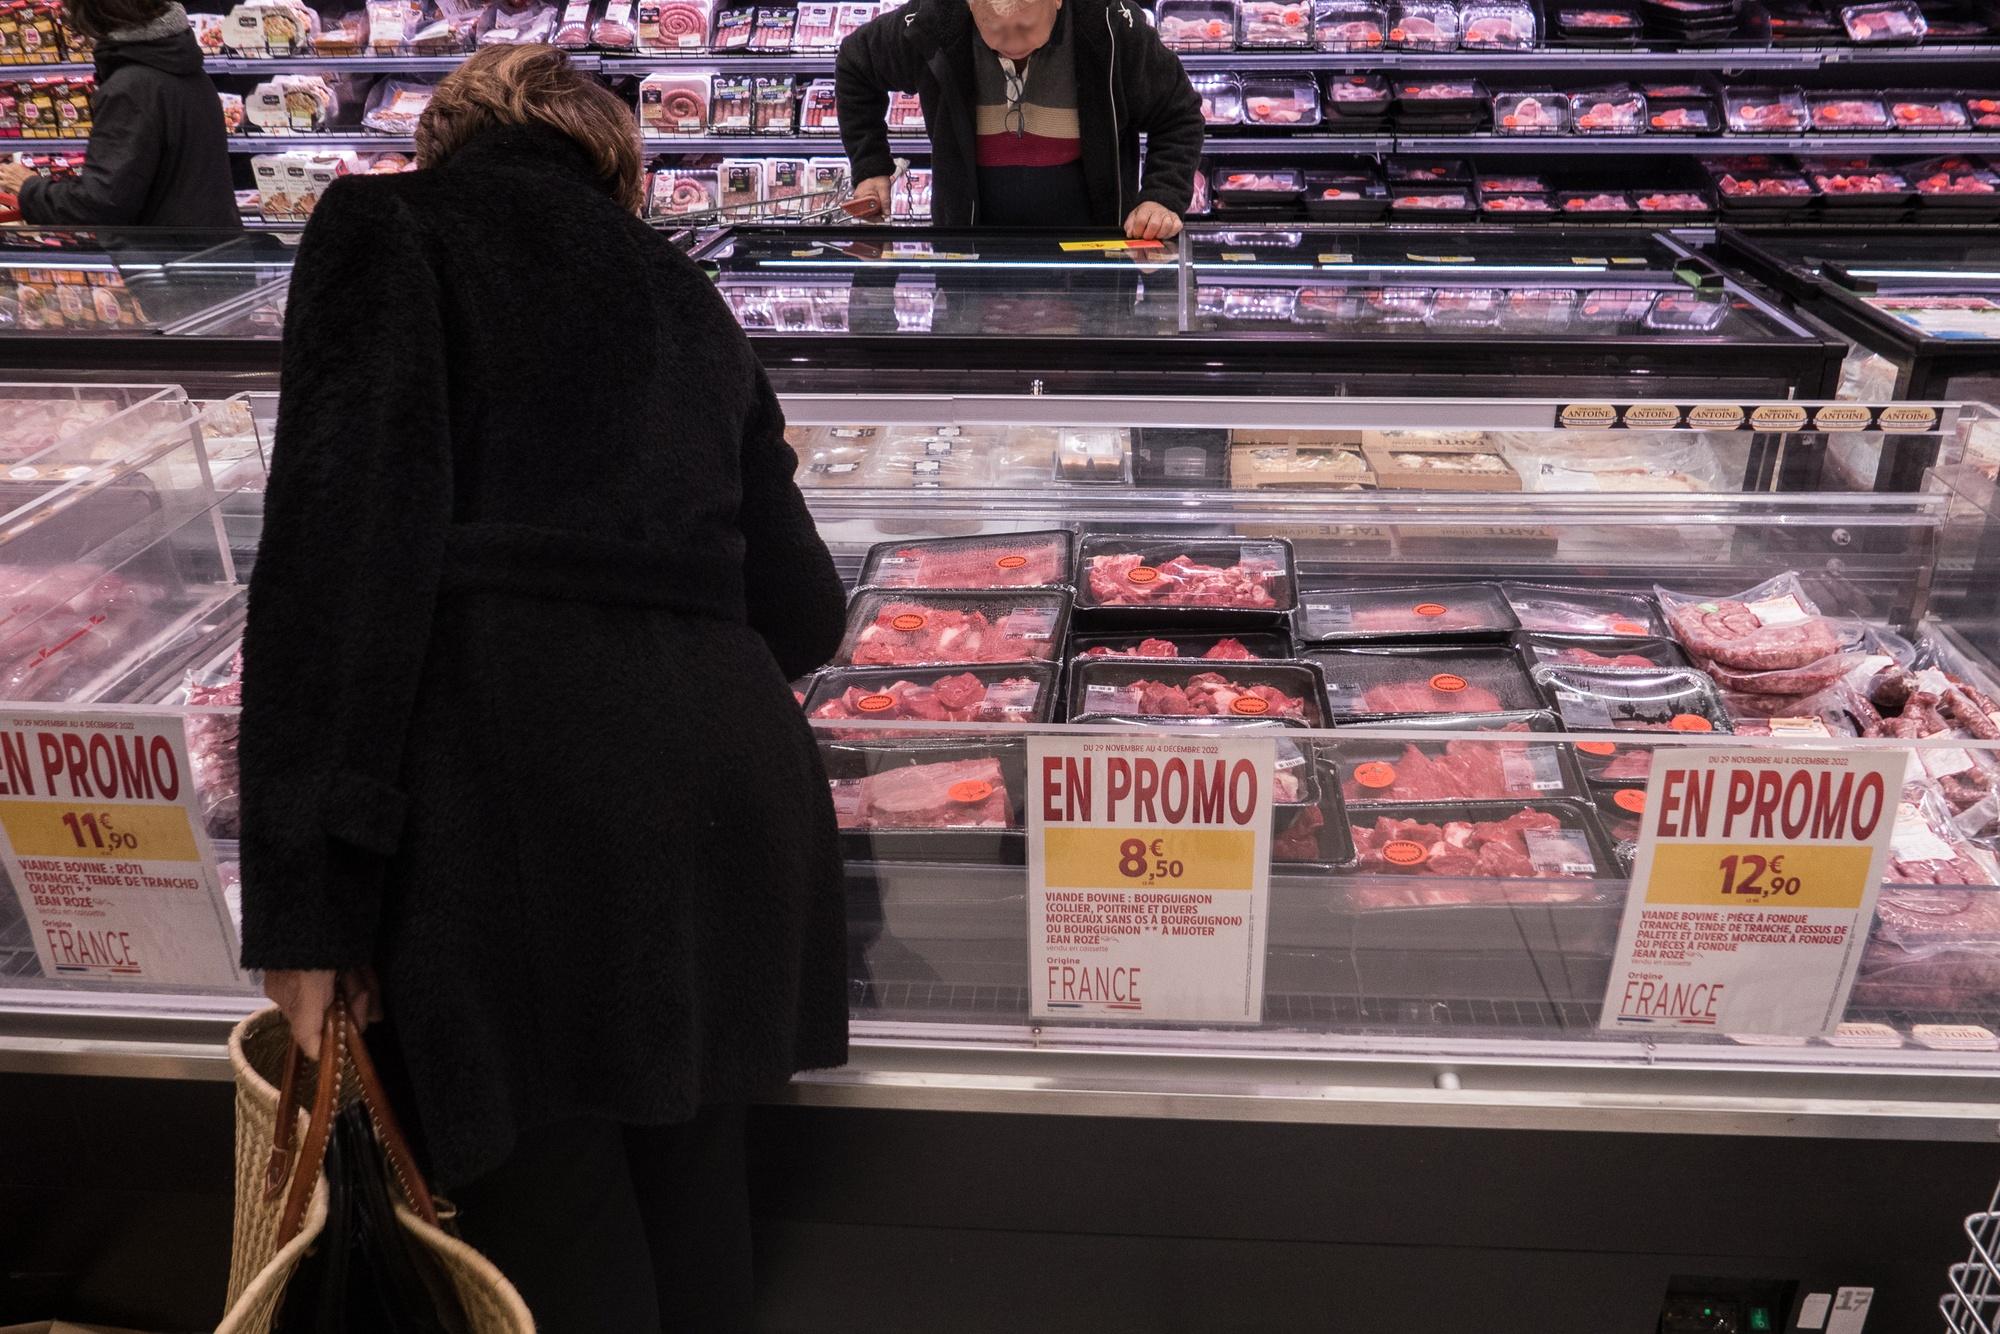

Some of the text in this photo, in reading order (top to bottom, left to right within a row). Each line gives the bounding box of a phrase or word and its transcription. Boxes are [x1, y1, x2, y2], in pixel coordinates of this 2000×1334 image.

[1568, 410, 1611, 418] ANTOINE
[1756, 412, 1800, 420] ANTOINE
[1821, 412, 1864, 420] ANTOINE
[1886, 413, 1931, 421] ANTOINE
[1083, 744, 1094, 752] DU
[1095, 744, 1104, 752] 29
[1105, 744, 1144, 753] NOVEMBRE
[1146, 745, 1156, 753] AU
[1157, 745, 1162, 753] 4
[1202, 746, 1219, 754] 2022
[0, 731, 180, 801] N PROMO
[1708, 756, 1720, 764] DU
[1720, 756, 1730, 764] 29
[1730, 756, 1772, 765] NOVEMBRE
[1773, 757, 1783, 765] AU
[1784, 757, 1790, 765] 4
[1831, 758, 1849, 766] 2022
[1043, 756, 1258, 825] EN PROMO
[1656, 769, 1885, 841] EN PROMO
[18, 860, 61, 872] VIANDE
[65, 861, 108, 874] BOVINE
[116, 863, 144, 875] RÔTI
[24, 872, 199, 890] (TRANCHE, TENDE DE TRANCHE)
[29, 883, 75, 896] OU RÔTI
[34, 895, 61, 907] JEAN
[1045, 893, 1084, 903] VIANDE
[1086, 893, 1125, 903] BOVINE
[1134, 893, 1212, 904] BOURGUIGNON
[1045, 903, 1198, 915] (COLLIER, POITRINE ET DIVERS
[1046, 914, 1103, 924] MORCEAUX
[1105, 915, 1132, 925] SANS
[1134, 915, 1148, 925] OS
[1160, 915, 1243, 927] BOURGUIGNON)
[1641, 911, 1680, 921] VIANDE
[1680, 912, 1719, 922] BOVINE
[1766, 913, 1808, 924] FONDUE
[42, 920, 73, 928] Origine
[1046, 924, 1215, 936] OU BOURGUIGNON À MIJOTER
[1639, 921, 1848, 935] (TRANCHE, TENDE DE TRANCHE, DESSUS DE
[1046, 935, 1073, 944] JEAN
[1074, 934, 1101, 945] ROZÉ
[1636, 930, 1678, 940] PALETTE
[1679, 930, 1692, 941] ET
[1693, 931, 1728, 942] DIVERS
[1730, 932, 1786, 944] MORCEAUX
[1798, 934, 1843, 945] FONDUE)
[46, 929, 139, 966] FRANCE
[1634, 940, 1650, 949] OU
[1696, 942, 1738, 952] FONDUE
[1632, 949, 1657, 959] JEAN
[1046, 957, 1081, 965] Origine
[1628, 972, 1663, 980] Origine
[1048, 966, 1142, 1002] FRANCE
[1620, 981, 1724, 1017] FRANCE
[1835, 1290, 1871, 1312] 17
